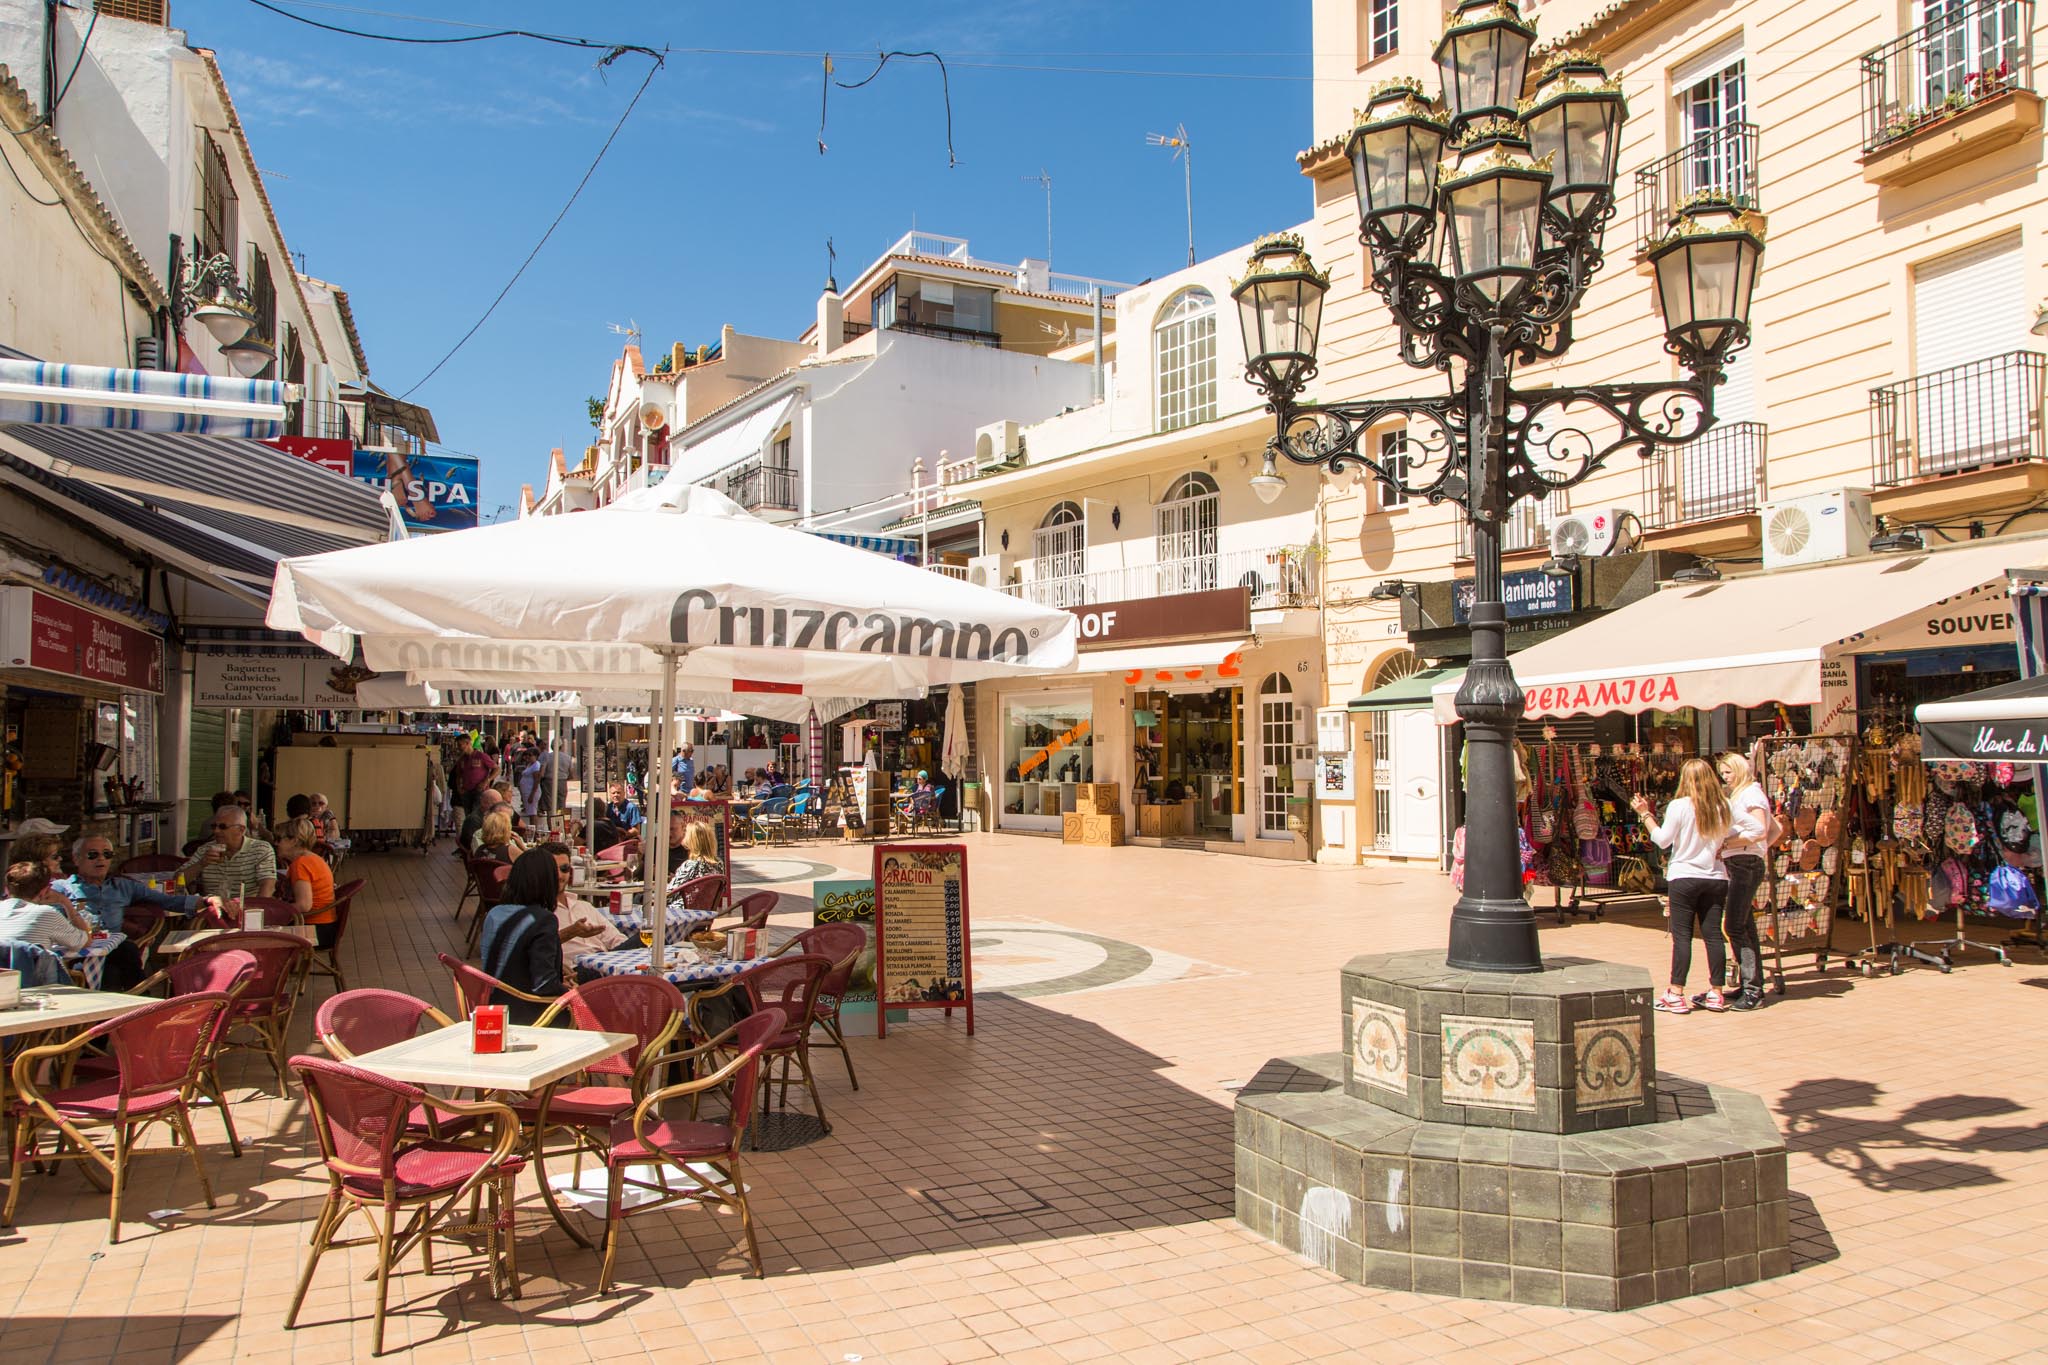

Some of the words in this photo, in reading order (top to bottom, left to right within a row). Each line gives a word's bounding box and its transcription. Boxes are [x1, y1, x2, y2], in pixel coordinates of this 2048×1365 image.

[408, 480, 470, 504] SPA
[1594, 532, 1605, 540] LG
[1501, 574, 1556, 602] animals
[1527, 601, 1539, 611] and
[1540, 600, 1557, 609] more
[1387, 623, 1399, 635] 67
[1533, 619, 1570, 631] T-Shirts
[86, 646, 96, 669] El
[226, 663, 276, 675] Baguettes
[1297, 662, 1308, 673] 65
[220, 672, 281, 683] Sandwiches
[224, 682, 276, 694] Camperos
[1525, 676, 1680, 712] CERAMICA
[200, 692, 252, 702] Ensaladas
[255, 692, 299, 702] Variadas
[315, 694, 350, 703] Paellas
[1972, 726, 2015, 753] blanc
[2016, 728, 2036, 753] du
[893, 869, 932, 884] RACION
